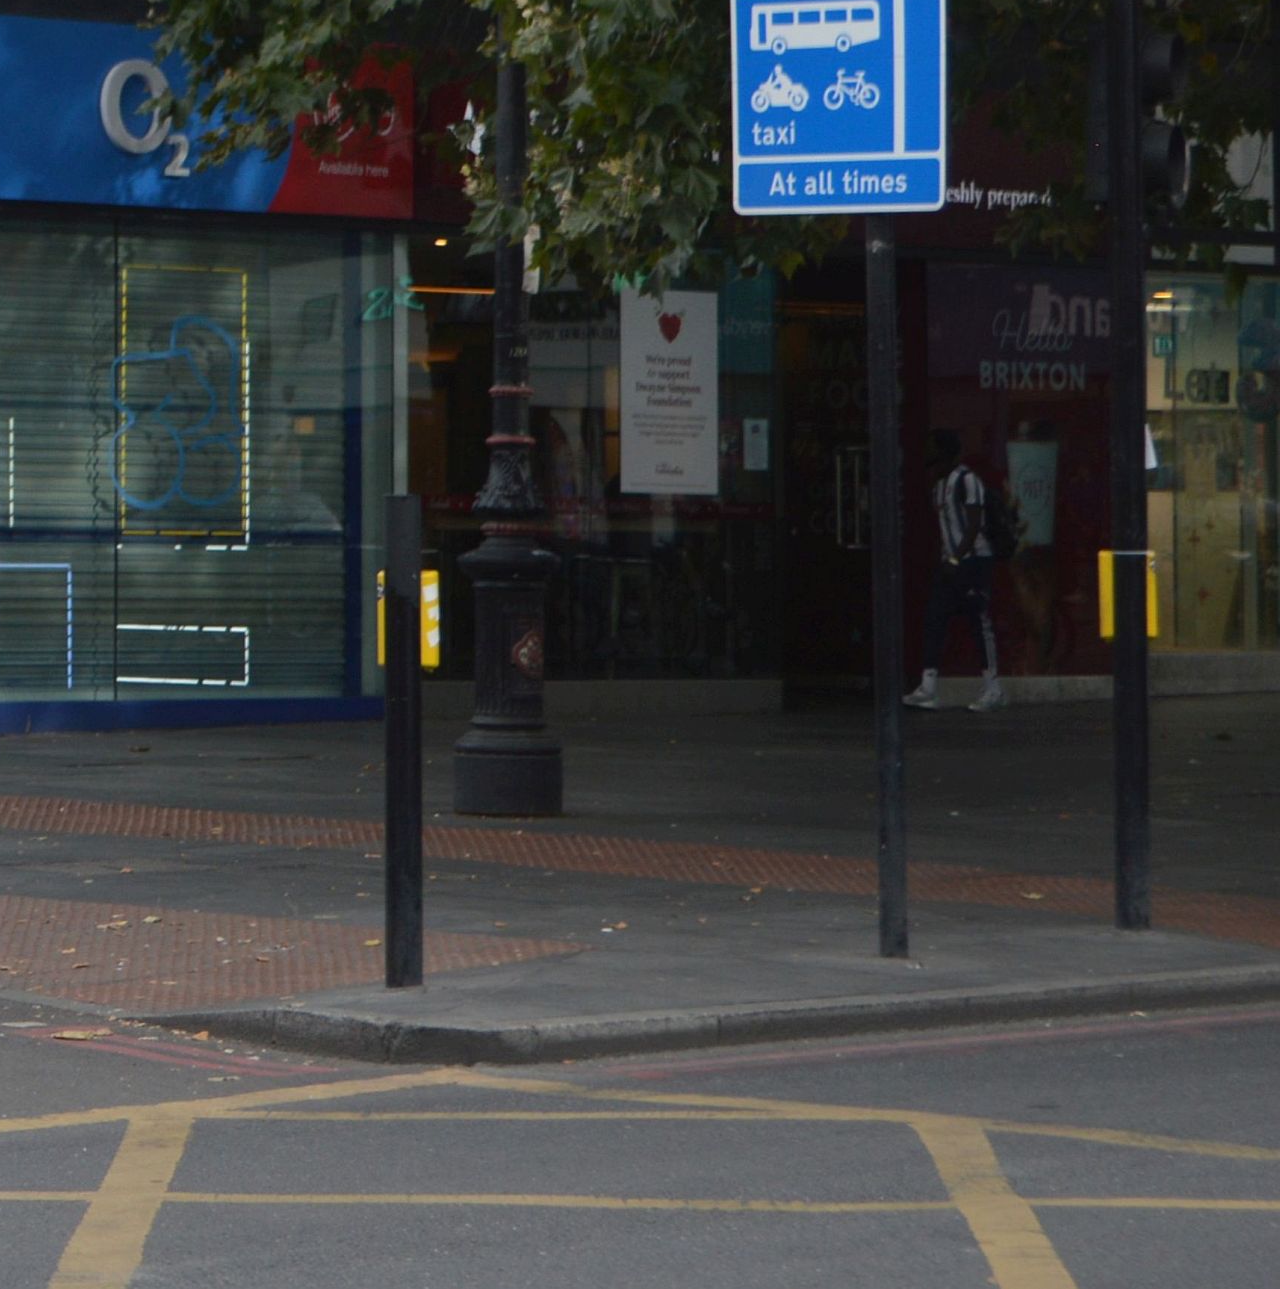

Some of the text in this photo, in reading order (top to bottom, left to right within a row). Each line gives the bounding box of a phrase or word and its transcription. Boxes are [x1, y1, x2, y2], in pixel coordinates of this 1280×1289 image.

[751, 120, 797, 145] taxi
[319, 161, 389, 179] Available here
[769, 168, 908, 196] At all times
[945, 180, 983, 209] eshly
[658, 370, 691, 383] support
[978, 360, 1088, 393] BRIXTON
